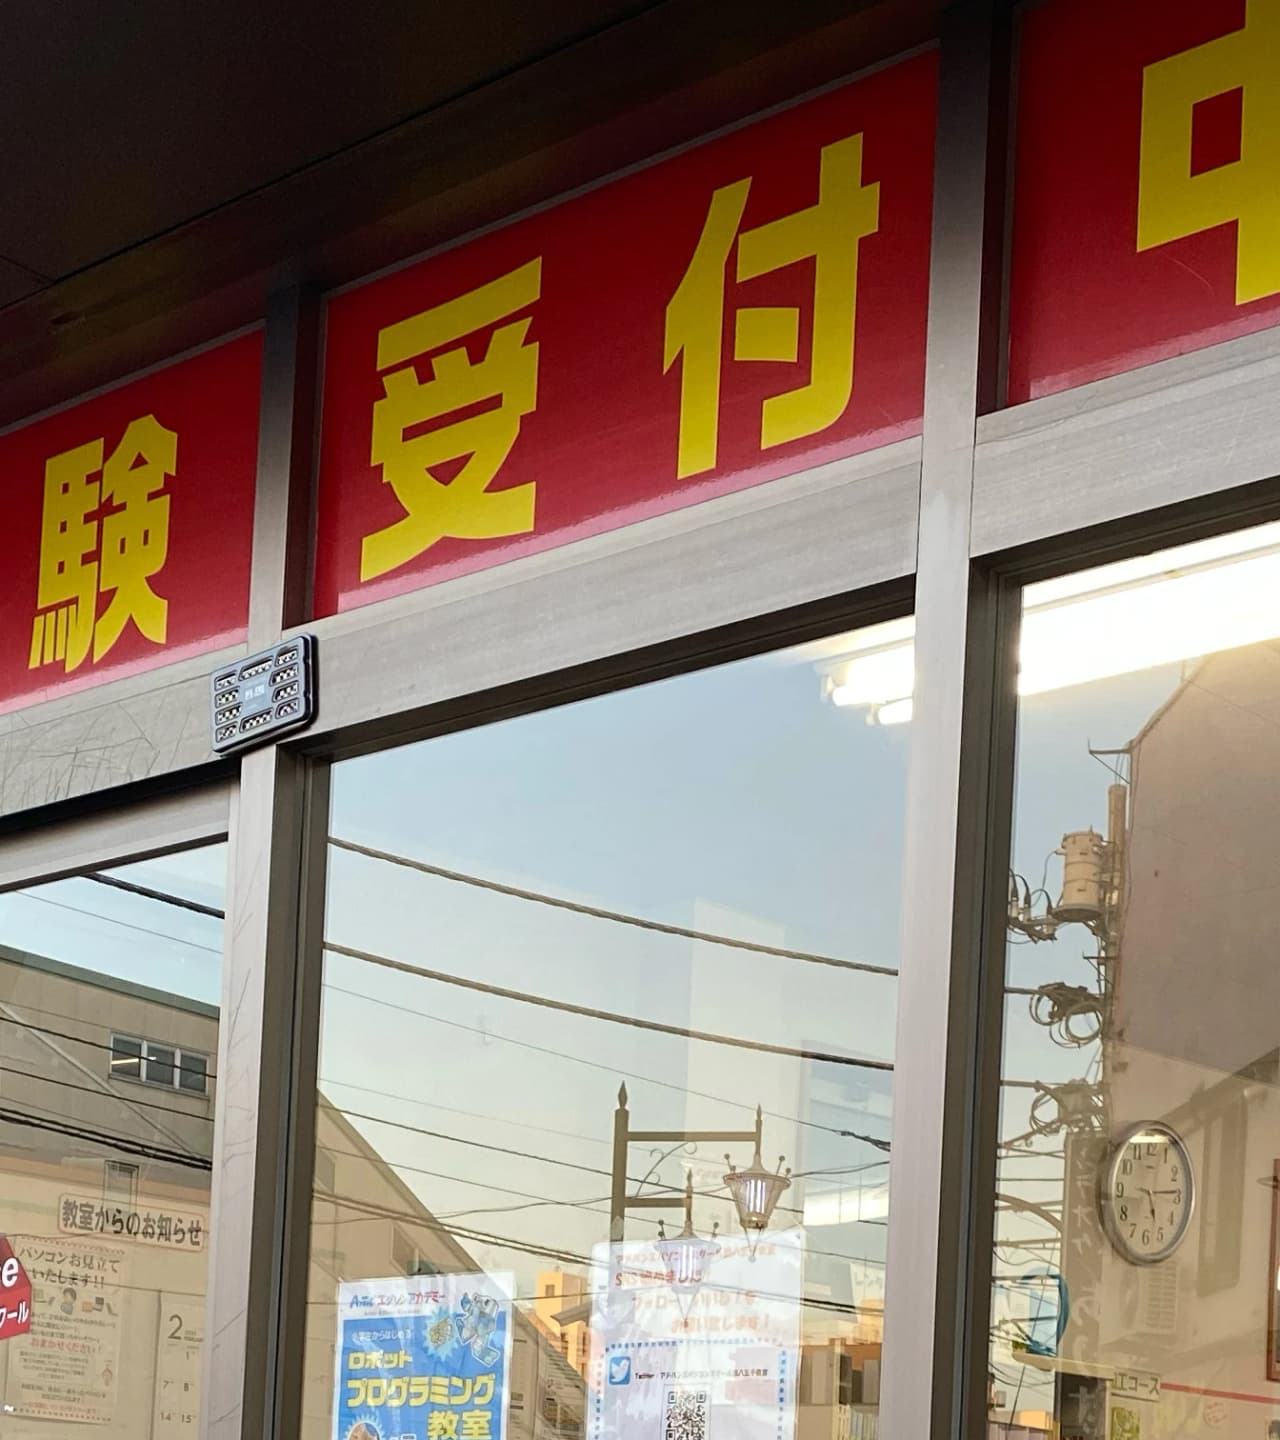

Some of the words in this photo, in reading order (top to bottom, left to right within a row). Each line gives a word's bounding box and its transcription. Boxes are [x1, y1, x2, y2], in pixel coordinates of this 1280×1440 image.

[360, 131, 880, 583] 受付
[61, 1199, 203, 1248] 教室からのお知らせ
[21, 1247, 121, 1273] パソコンお見立て
[167, 1314, 184, 1341] 2
[348, 1350, 413, 1370] ロボット
[347, 1373, 496, 1408] プログラミング
